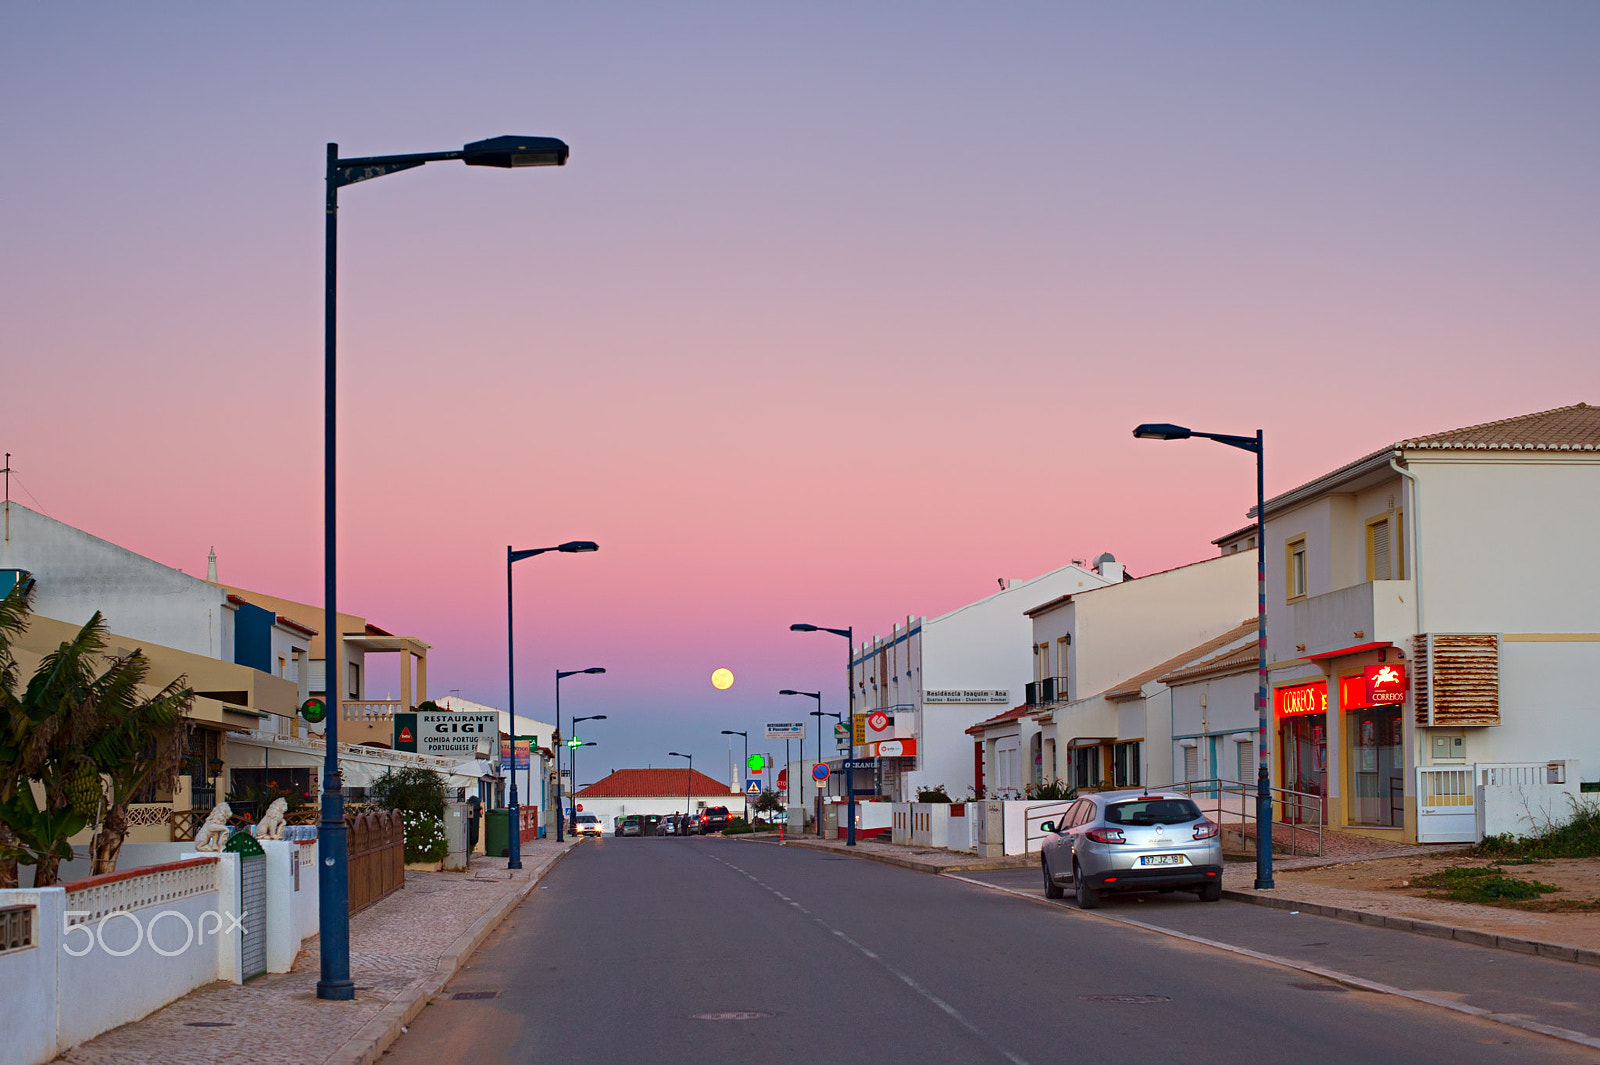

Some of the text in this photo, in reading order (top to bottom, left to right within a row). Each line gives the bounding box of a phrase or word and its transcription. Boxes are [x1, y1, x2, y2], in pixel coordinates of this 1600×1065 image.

[1284, 688, 1315, 713] CORREIOS
[1372, 693, 1404, 701] CORREIOS
[435, 723, 484, 733] GIGI
